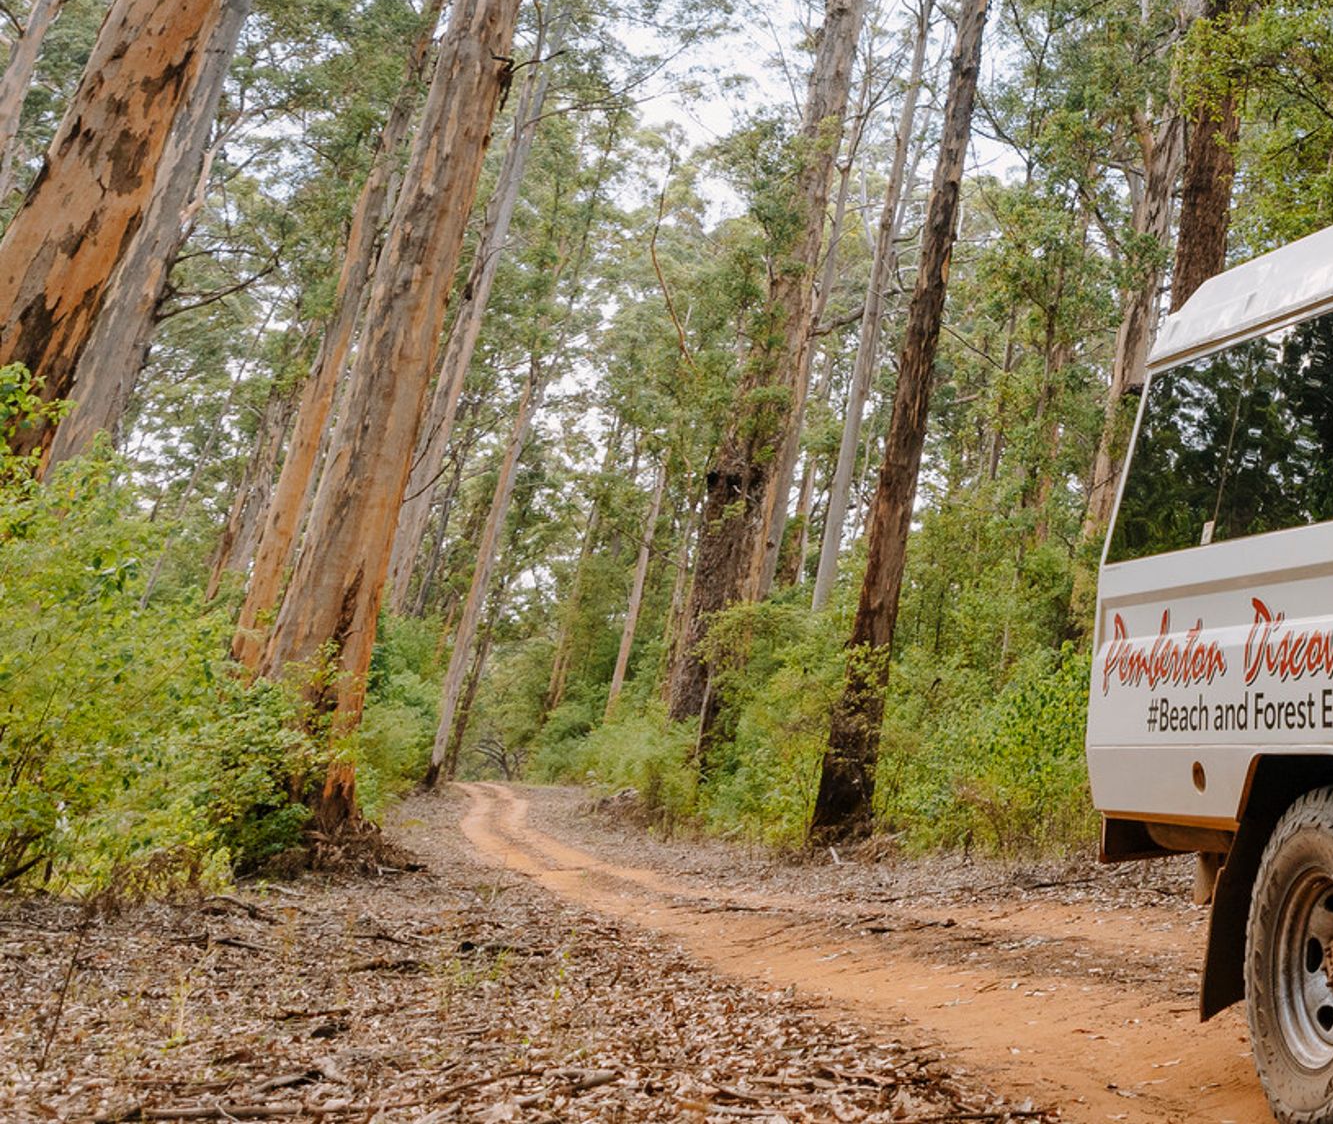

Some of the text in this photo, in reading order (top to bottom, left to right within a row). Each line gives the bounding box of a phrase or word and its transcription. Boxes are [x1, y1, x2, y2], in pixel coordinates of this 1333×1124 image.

[1102, 608, 1228, 696] Pemberton
[1147, 692, 1208, 733] #Beach
[1213, 691, 1248, 731] and
[1254, 692, 1316, 730] Forest
